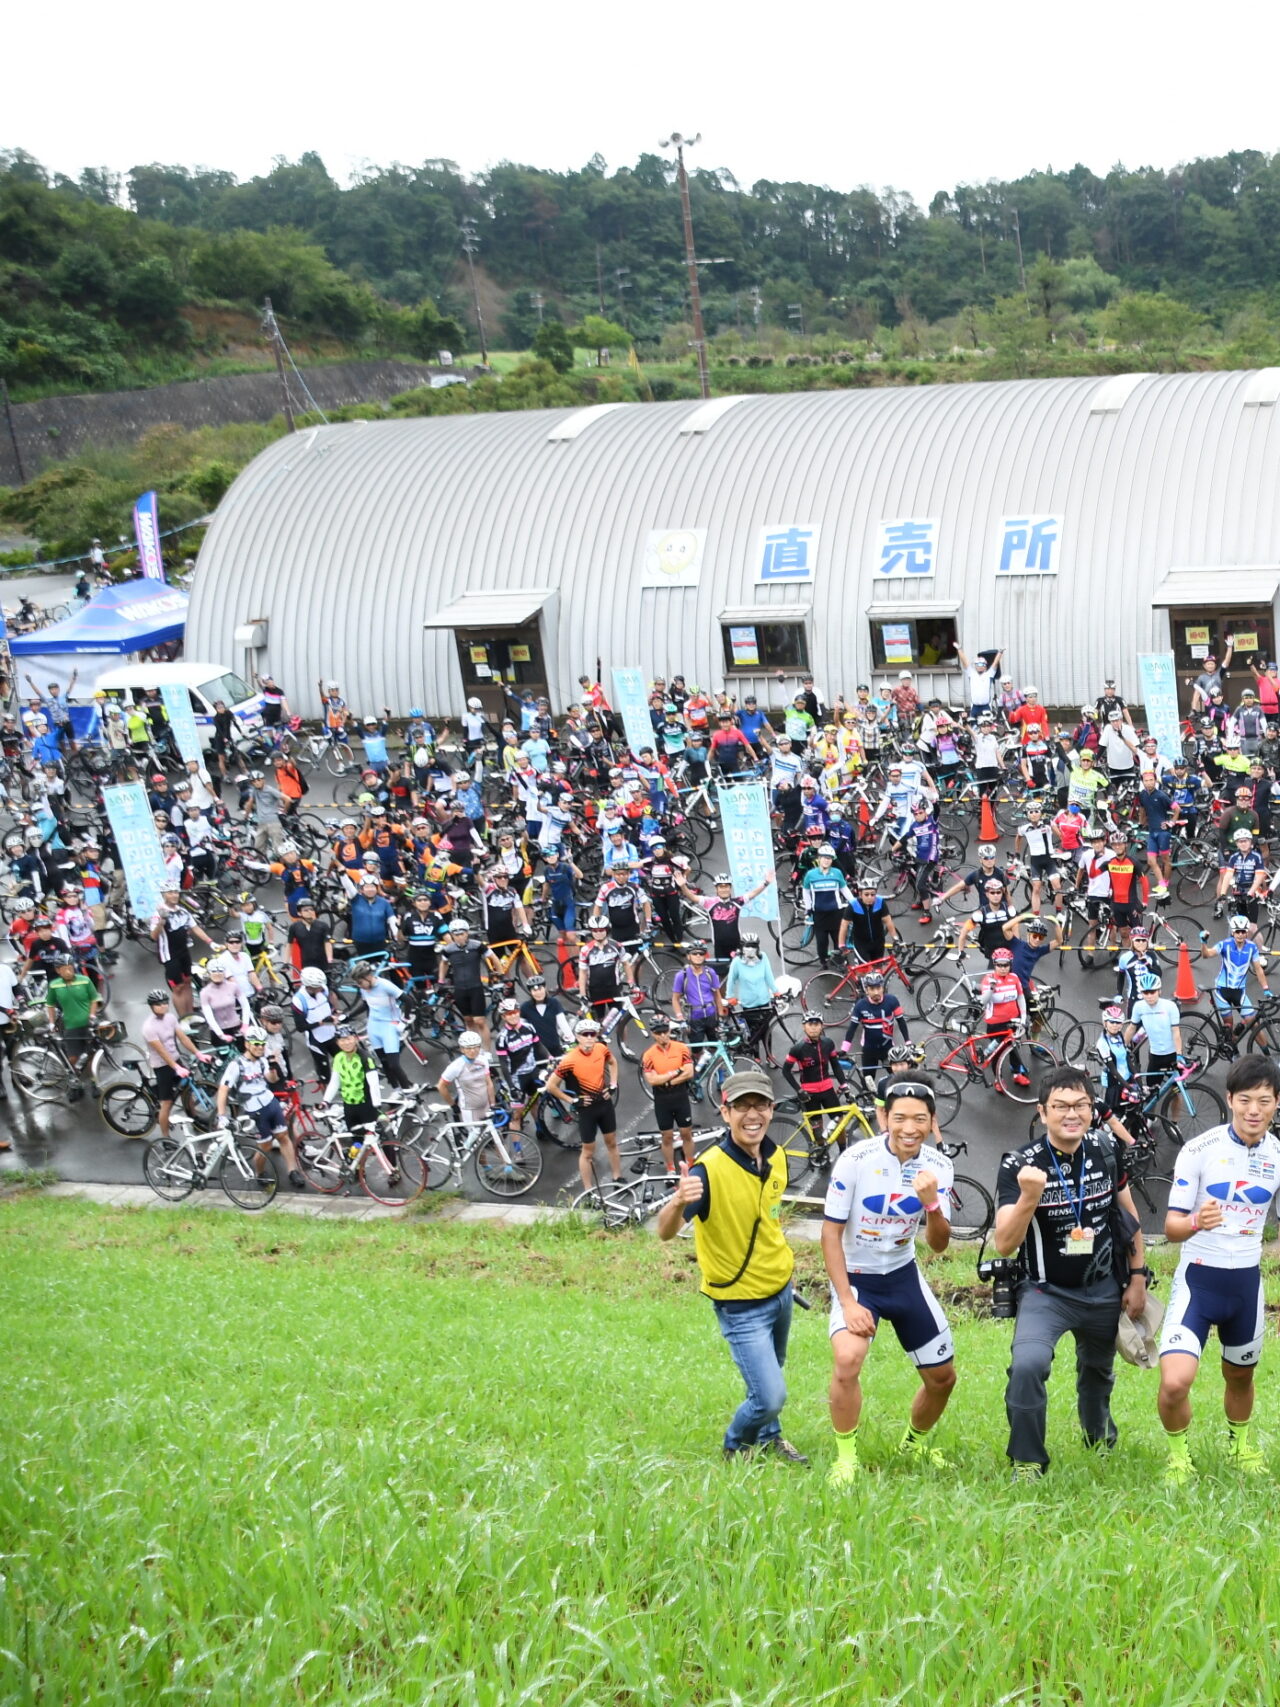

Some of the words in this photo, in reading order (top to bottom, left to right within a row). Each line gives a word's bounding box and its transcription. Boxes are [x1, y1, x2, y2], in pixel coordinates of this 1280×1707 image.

[760, 517, 1058, 580] 直売所
[1189, 1136, 1221, 1155] System
[1219, 1204, 1266, 1216] INAN
[861, 1215, 919, 1225] KINAN
